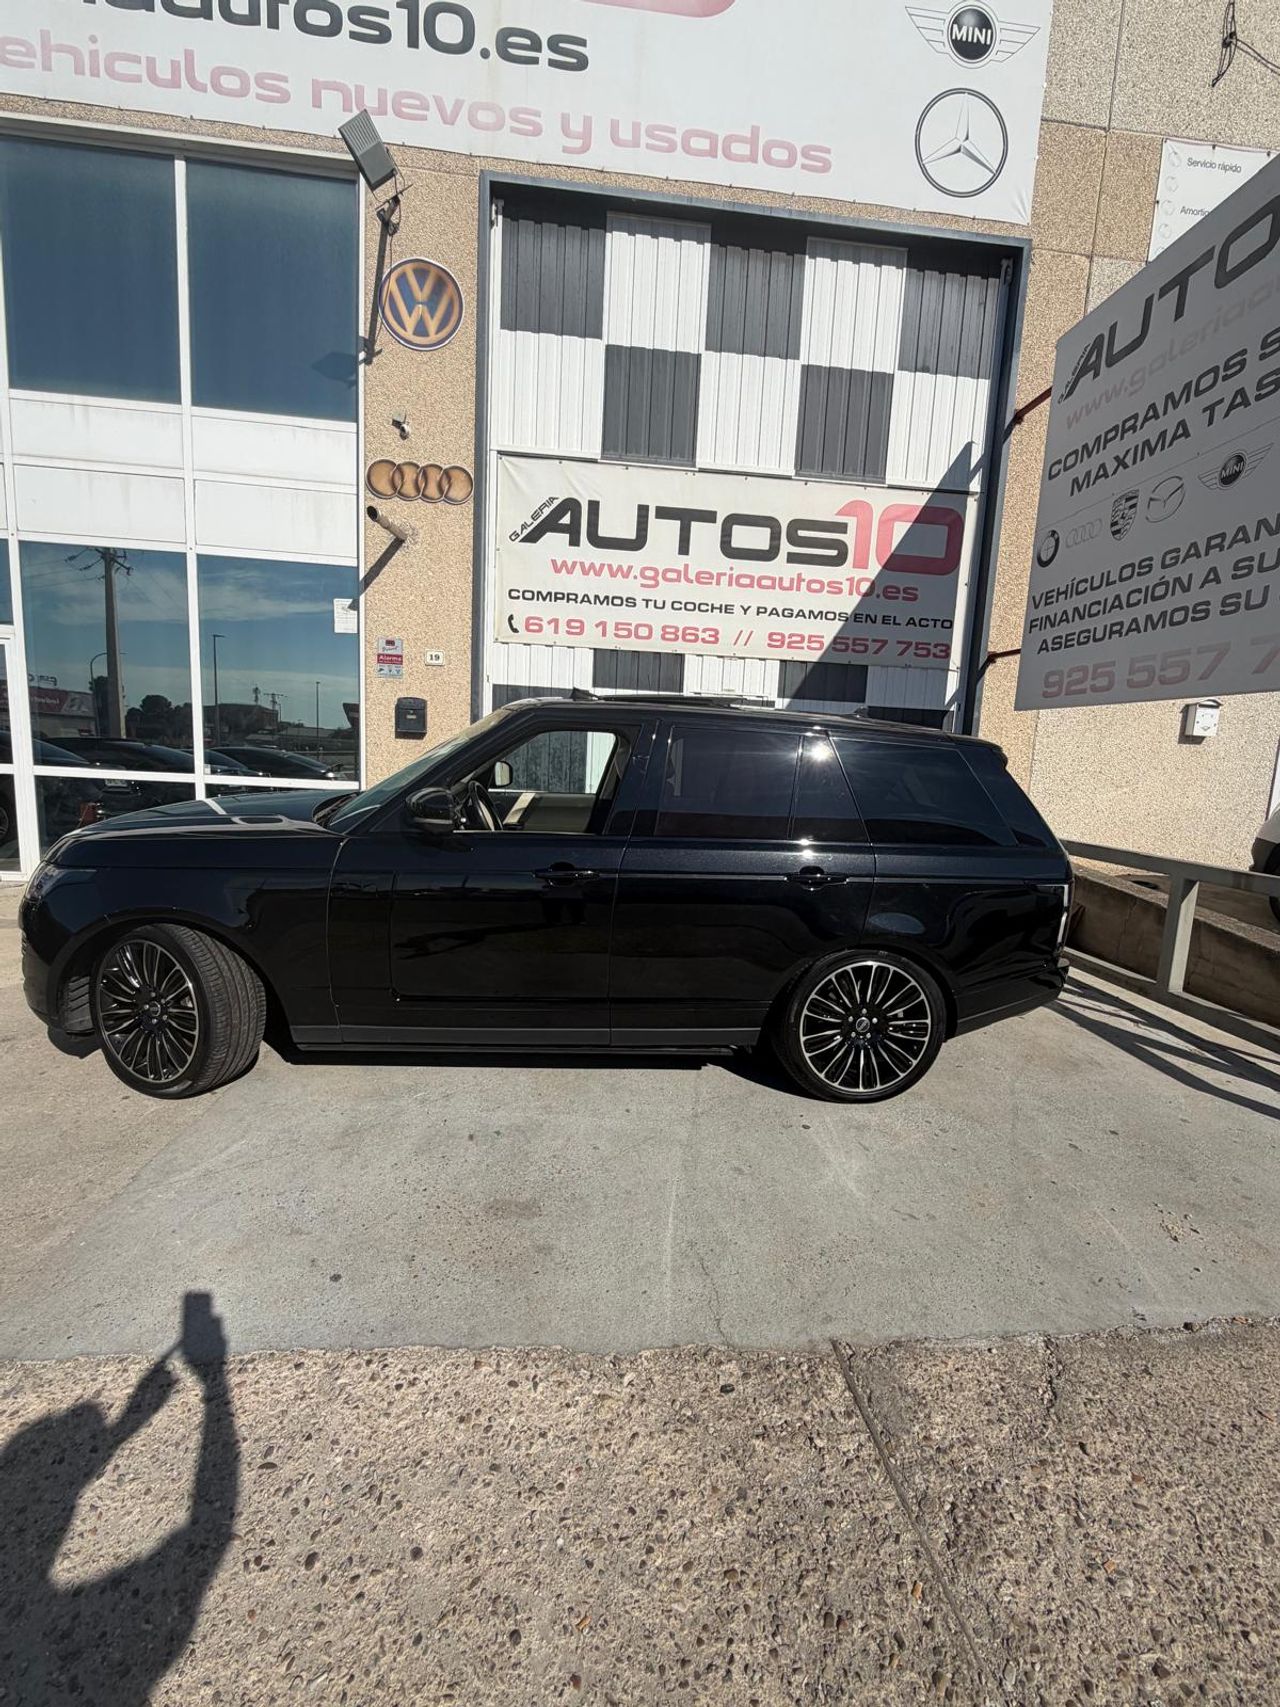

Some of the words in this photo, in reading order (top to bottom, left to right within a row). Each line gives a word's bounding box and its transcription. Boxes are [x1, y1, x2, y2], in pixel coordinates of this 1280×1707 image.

[951, 22, 992, 45] MINI
[311, 78, 544, 137] nuevos
[560, 111, 592, 154] y
[609, 117, 832, 174] usados
[1187, 157, 1217, 170] Servicio
[1218, 162, 1242, 174] rápido
[1048, 348, 1248, 479] COMPRAMOS
[1070, 418, 1191, 496] MAXIMA
[1202, 367, 1280, 427] TAS
[1220, 461, 1245, 478] MINI
[508, 496, 559, 542] GALERIA
[519, 497, 964, 576] AUTOS10
[550, 557, 919, 602] www.galeriaautos10.es
[1029, 573, 1193, 634] FINANCIACIÓN
[1199, 566, 1222, 590] A
[1231, 547, 1280, 580] SU
[1031, 555, 1153, 610] VEHÍCULOS
[507, 588, 638, 608] COMPRAMOS
[642, 598, 668, 610] TU
[671, 600, 735, 615] COCHE
[739, 605, 752, 616] Y
[756, 605, 849, 622] PAGAMOS
[853, 613, 878, 624] EN
[882, 615, 902, 627] EL
[905, 617, 954, 630] ACTO
[1037, 600, 1211, 654] ASEGURAMOS
[1219, 584, 1270, 616] SU
[430, 653, 440, 661] 19
[524, 615, 585, 636] 619
[594, 619, 653, 641] 150
[660, 625, 720, 645] 863
[733, 629, 754, 647] //
[767, 631, 824, 651] 925
[831, 634, 887, 655] 557
[895, 639, 952, 659] 753
[1042, 660, 1116, 699] 925
[1126, 640, 1231, 689] 557
